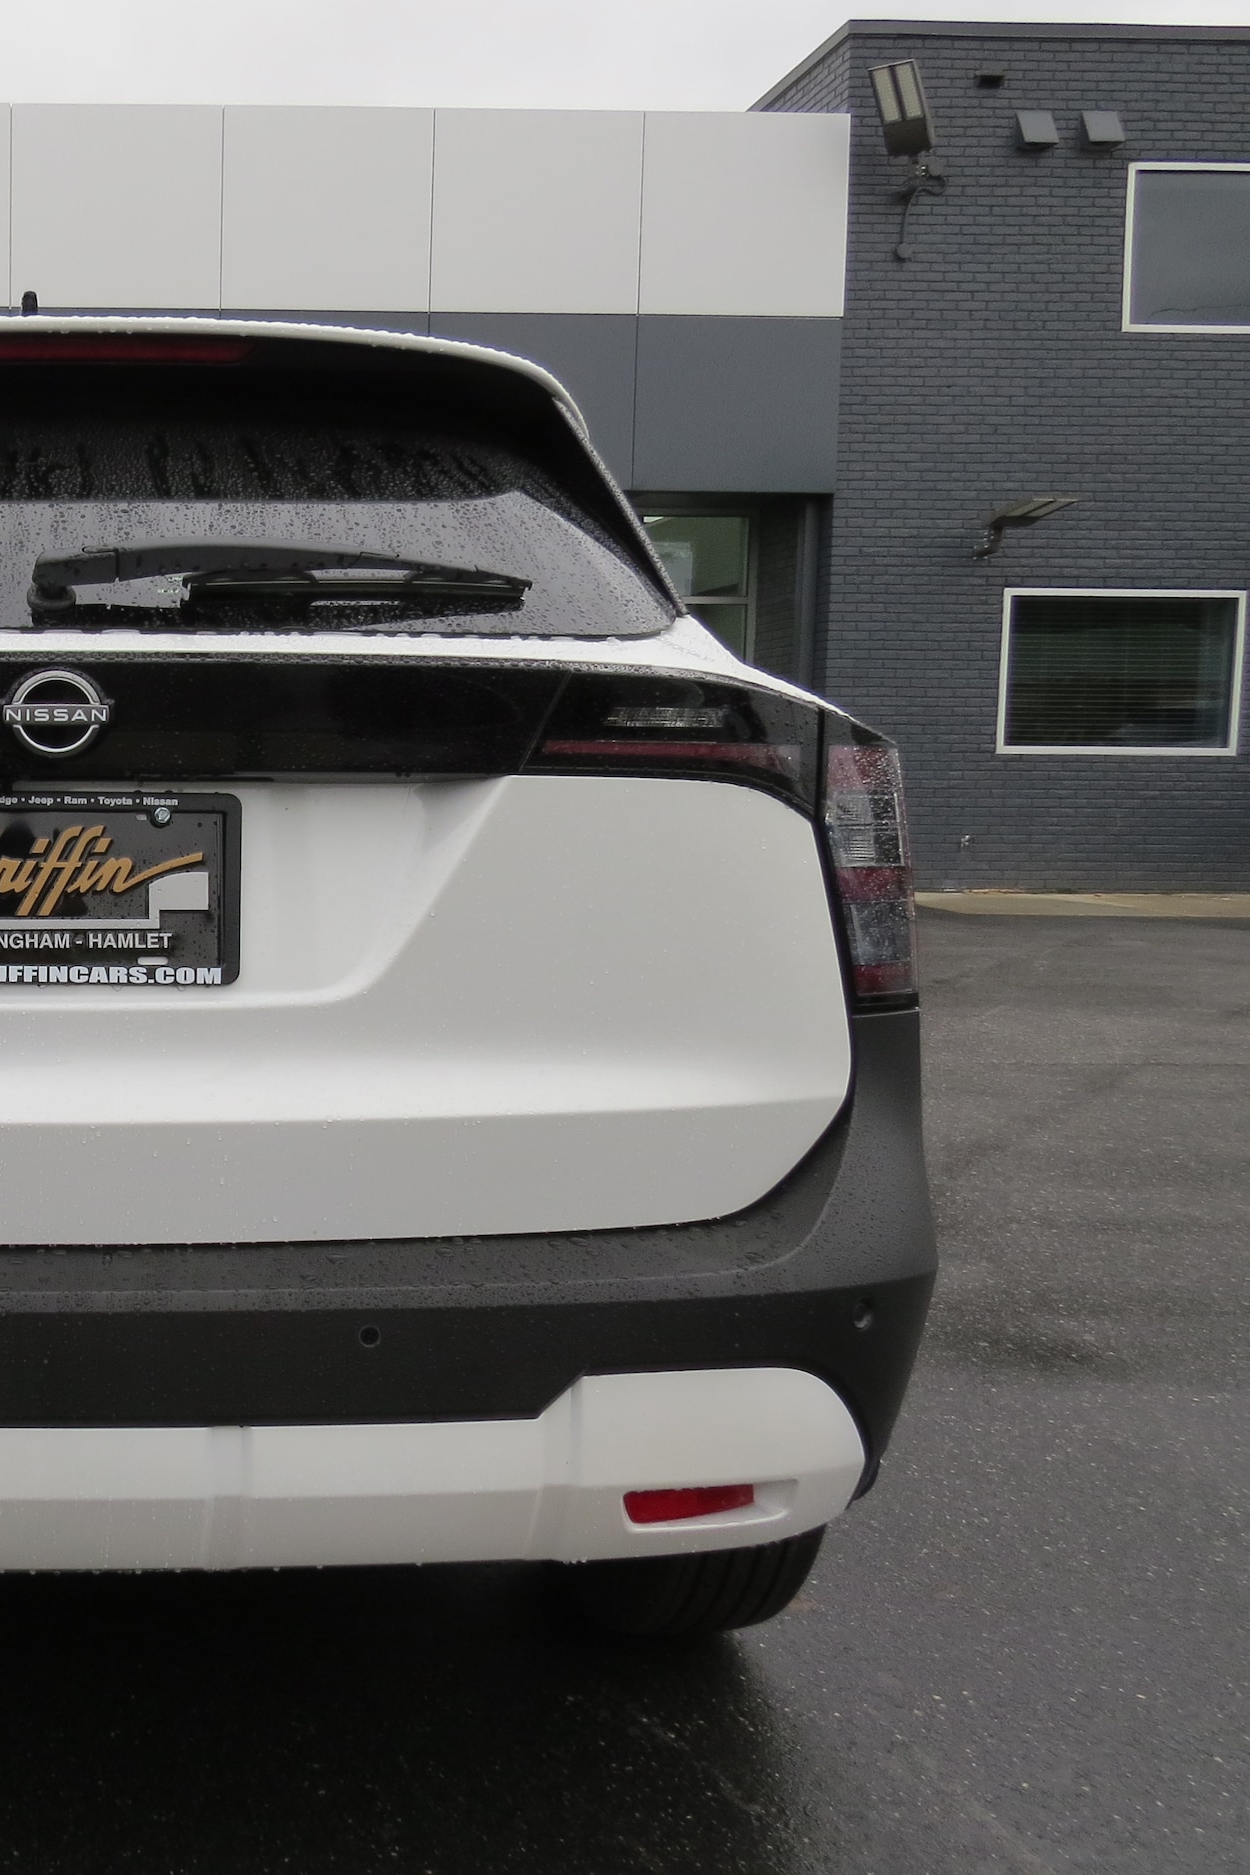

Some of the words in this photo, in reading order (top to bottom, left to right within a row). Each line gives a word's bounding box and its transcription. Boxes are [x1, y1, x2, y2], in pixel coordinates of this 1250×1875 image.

[6, 708, 106, 722] NISSAN
[28, 796, 54, 806] Jeep
[64, 796, 87, 805] Ram
[98, 796, 132, 806] Toyota
[142, 797, 178, 806] Nissan
[88, 933, 172, 949] HAMLET
